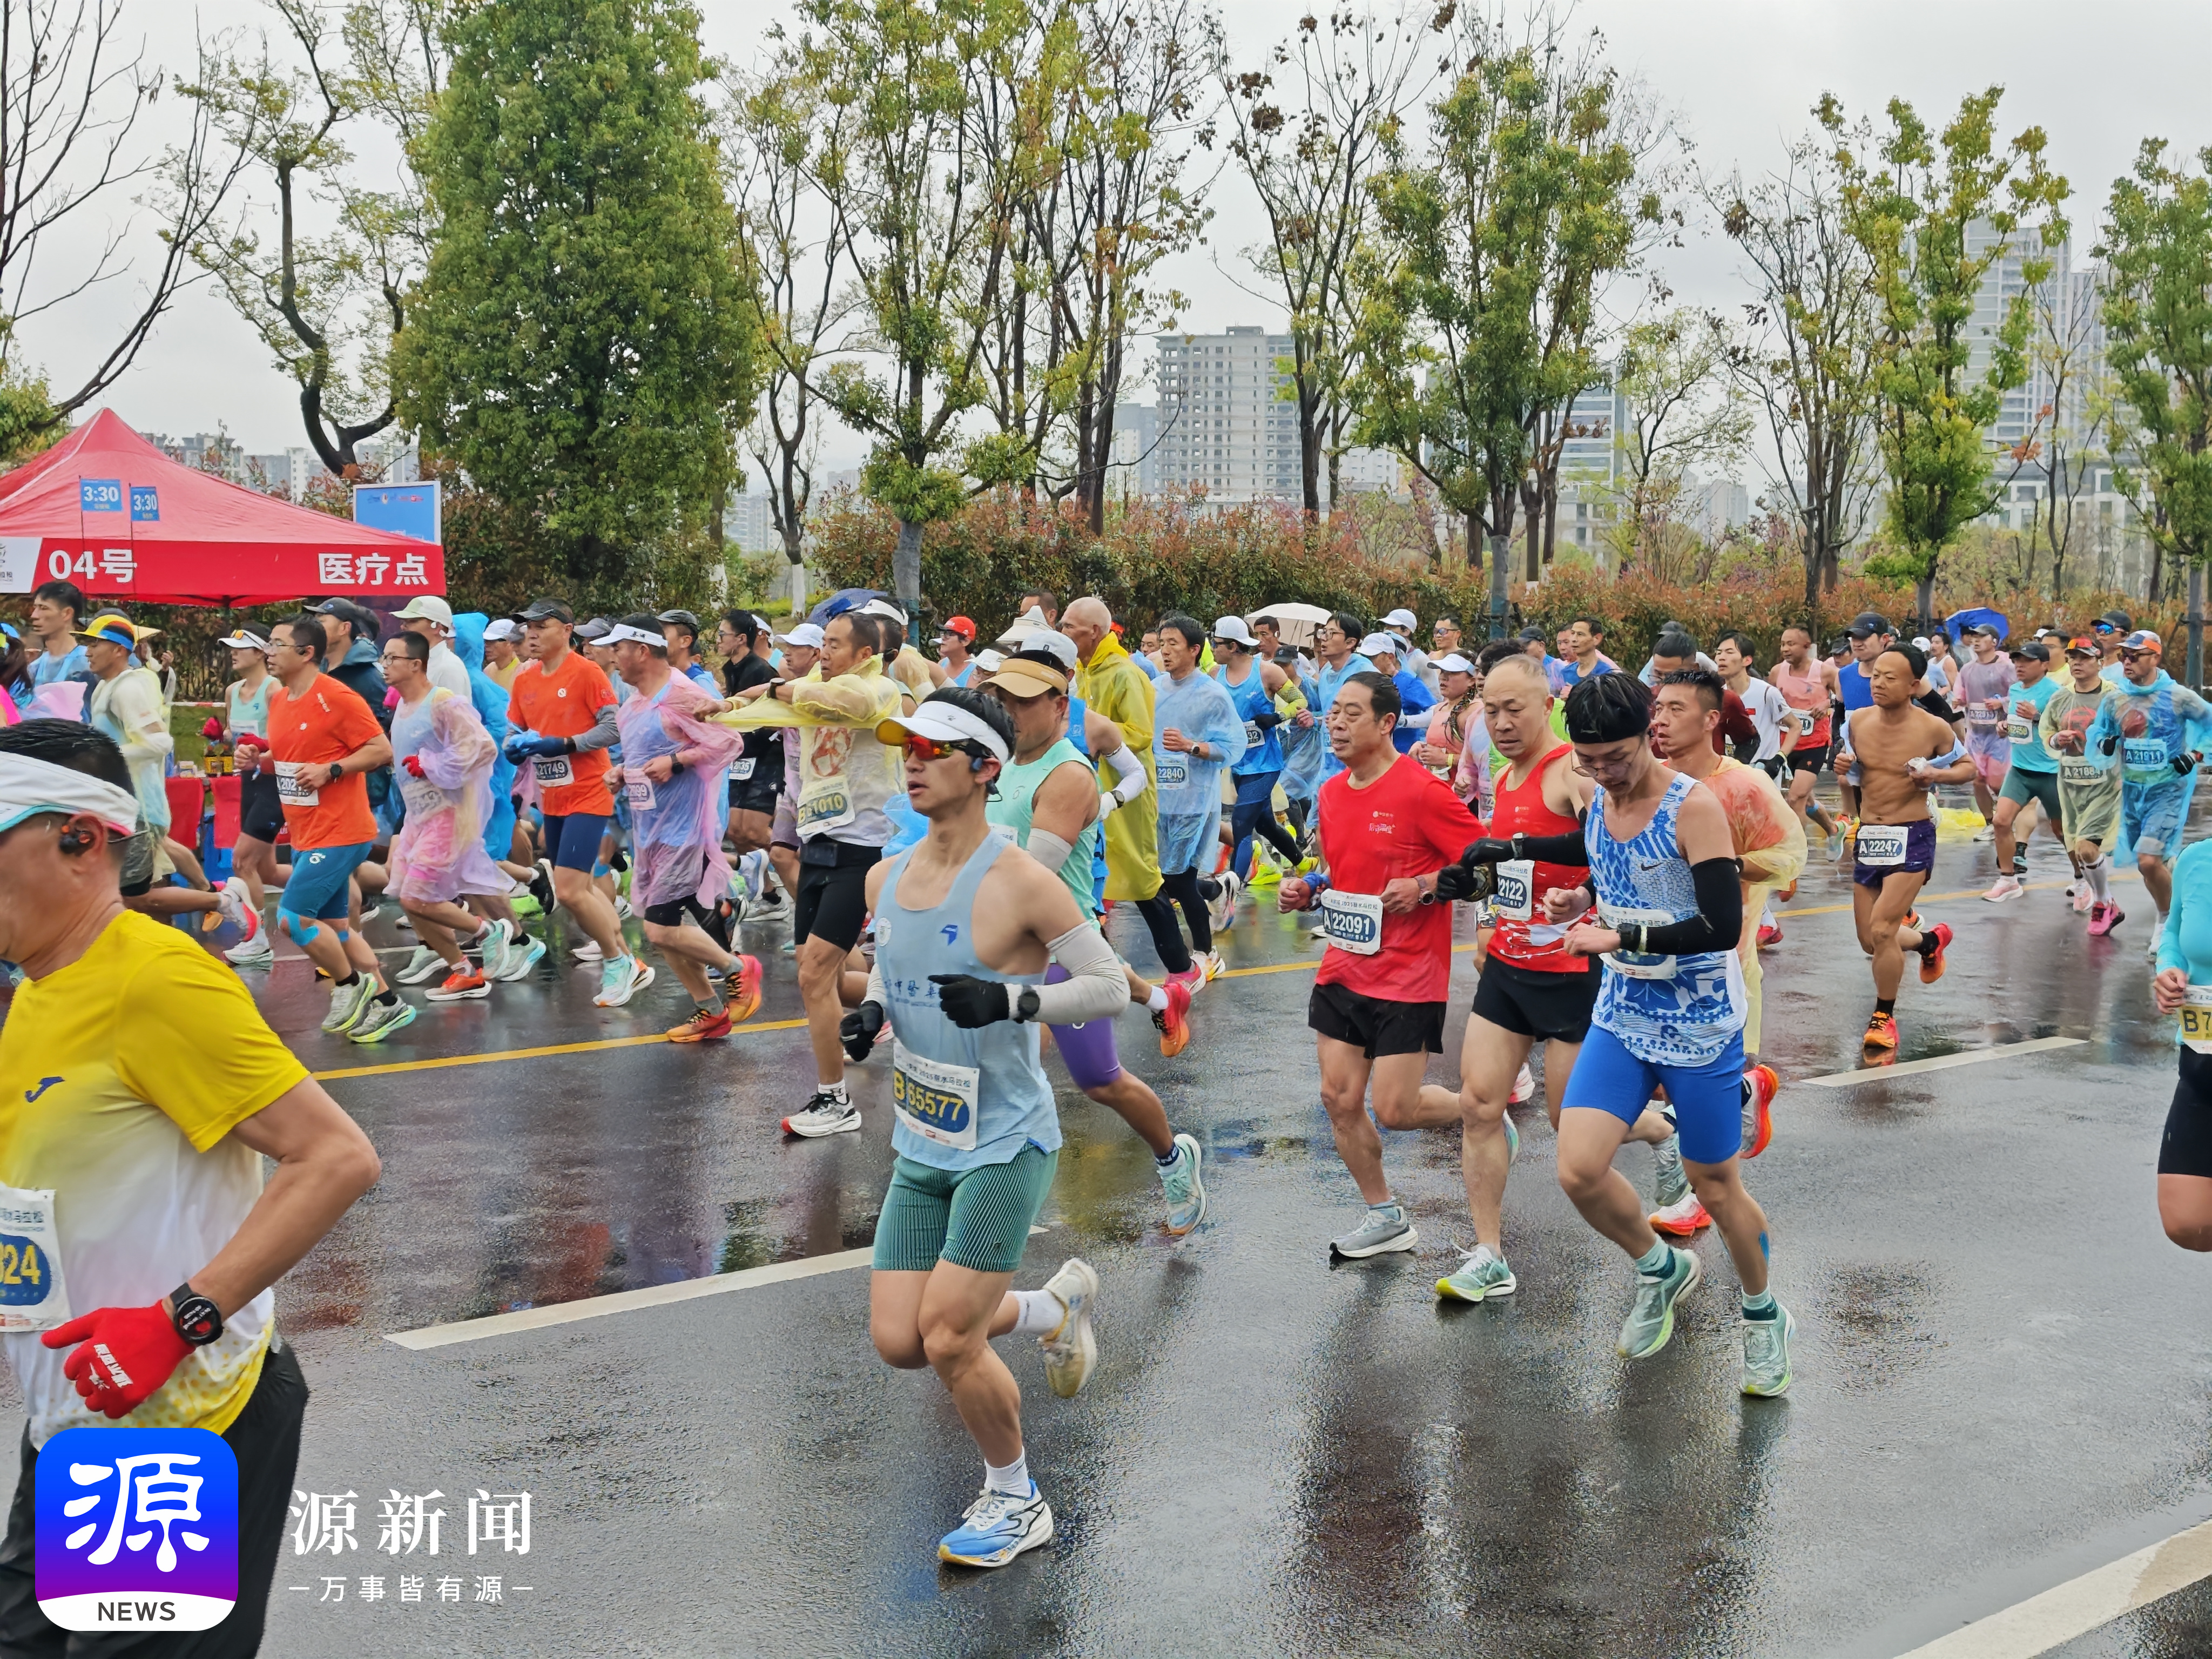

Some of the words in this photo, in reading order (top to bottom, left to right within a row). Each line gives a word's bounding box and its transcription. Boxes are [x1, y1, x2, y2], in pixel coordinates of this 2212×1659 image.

[84, 486, 119, 502] 3:30
[133, 494, 158, 511] 3:30
[49, 549, 138, 583] 04号
[318, 552, 429, 585] 医疗点
[536, 761, 565, 774] 21749
[1859, 840, 1900, 854] A22247
[1324, 909, 1370, 935] A22091
[894, 1071, 964, 1121] B65577
[0, 1244, 41, 1285] 24
